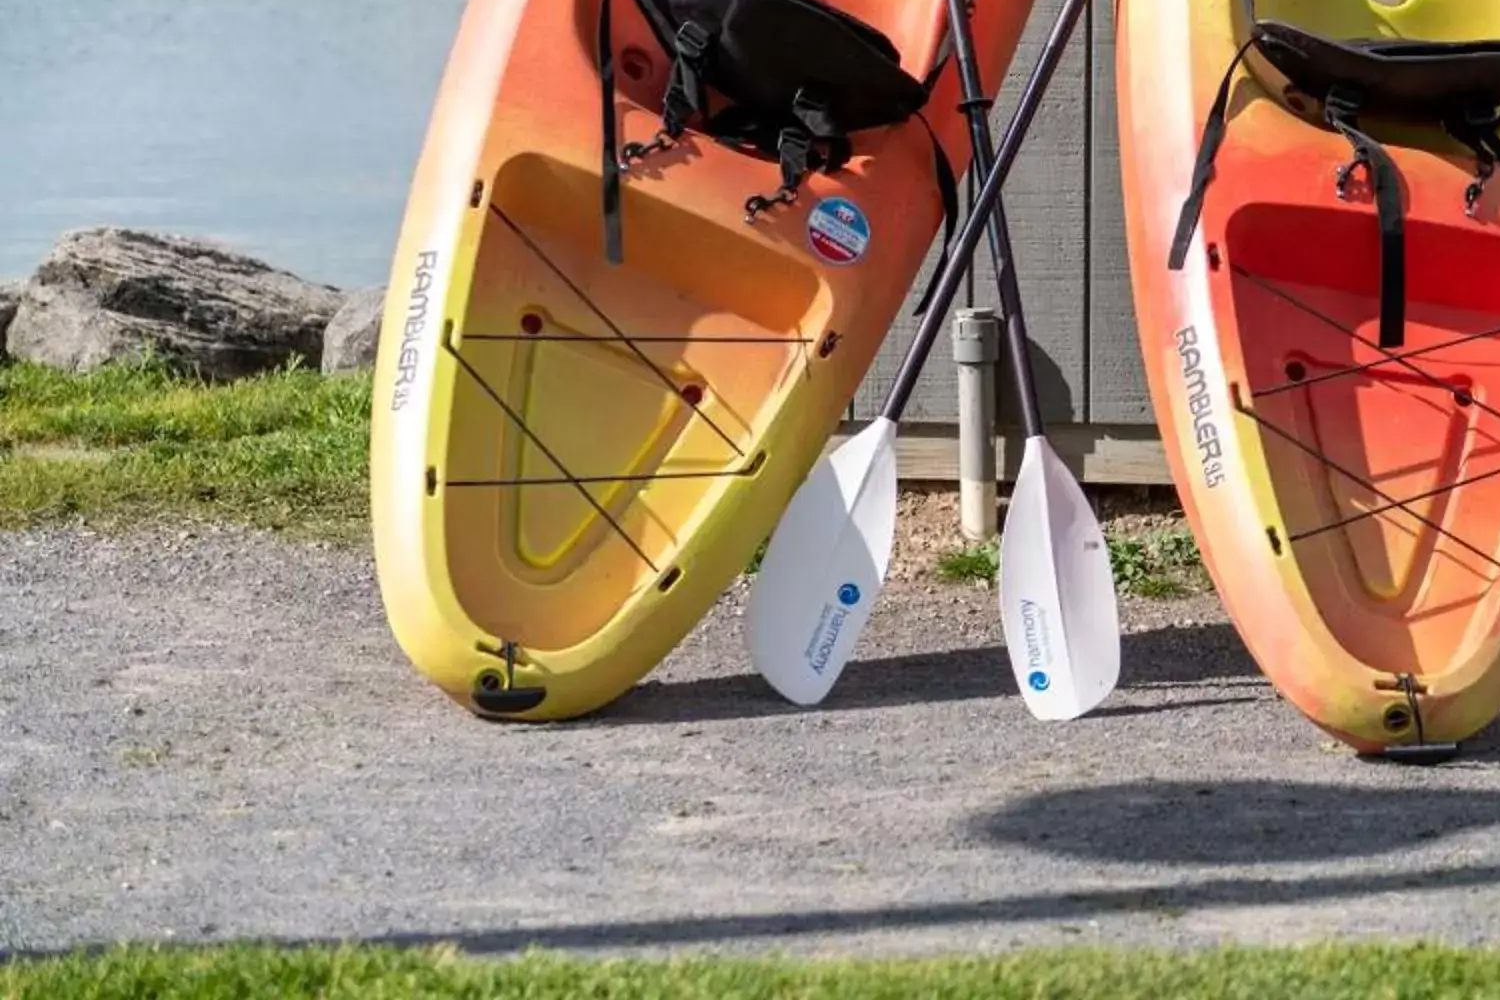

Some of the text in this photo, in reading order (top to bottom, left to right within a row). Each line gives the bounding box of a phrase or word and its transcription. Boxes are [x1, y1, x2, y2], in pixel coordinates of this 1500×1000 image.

[394, 250, 438, 387] RAMBLER
[1176, 324, 1223, 464] RAMBLER
[809, 606, 851, 677] harmony
[1020, 599, 1042, 668] harmony
